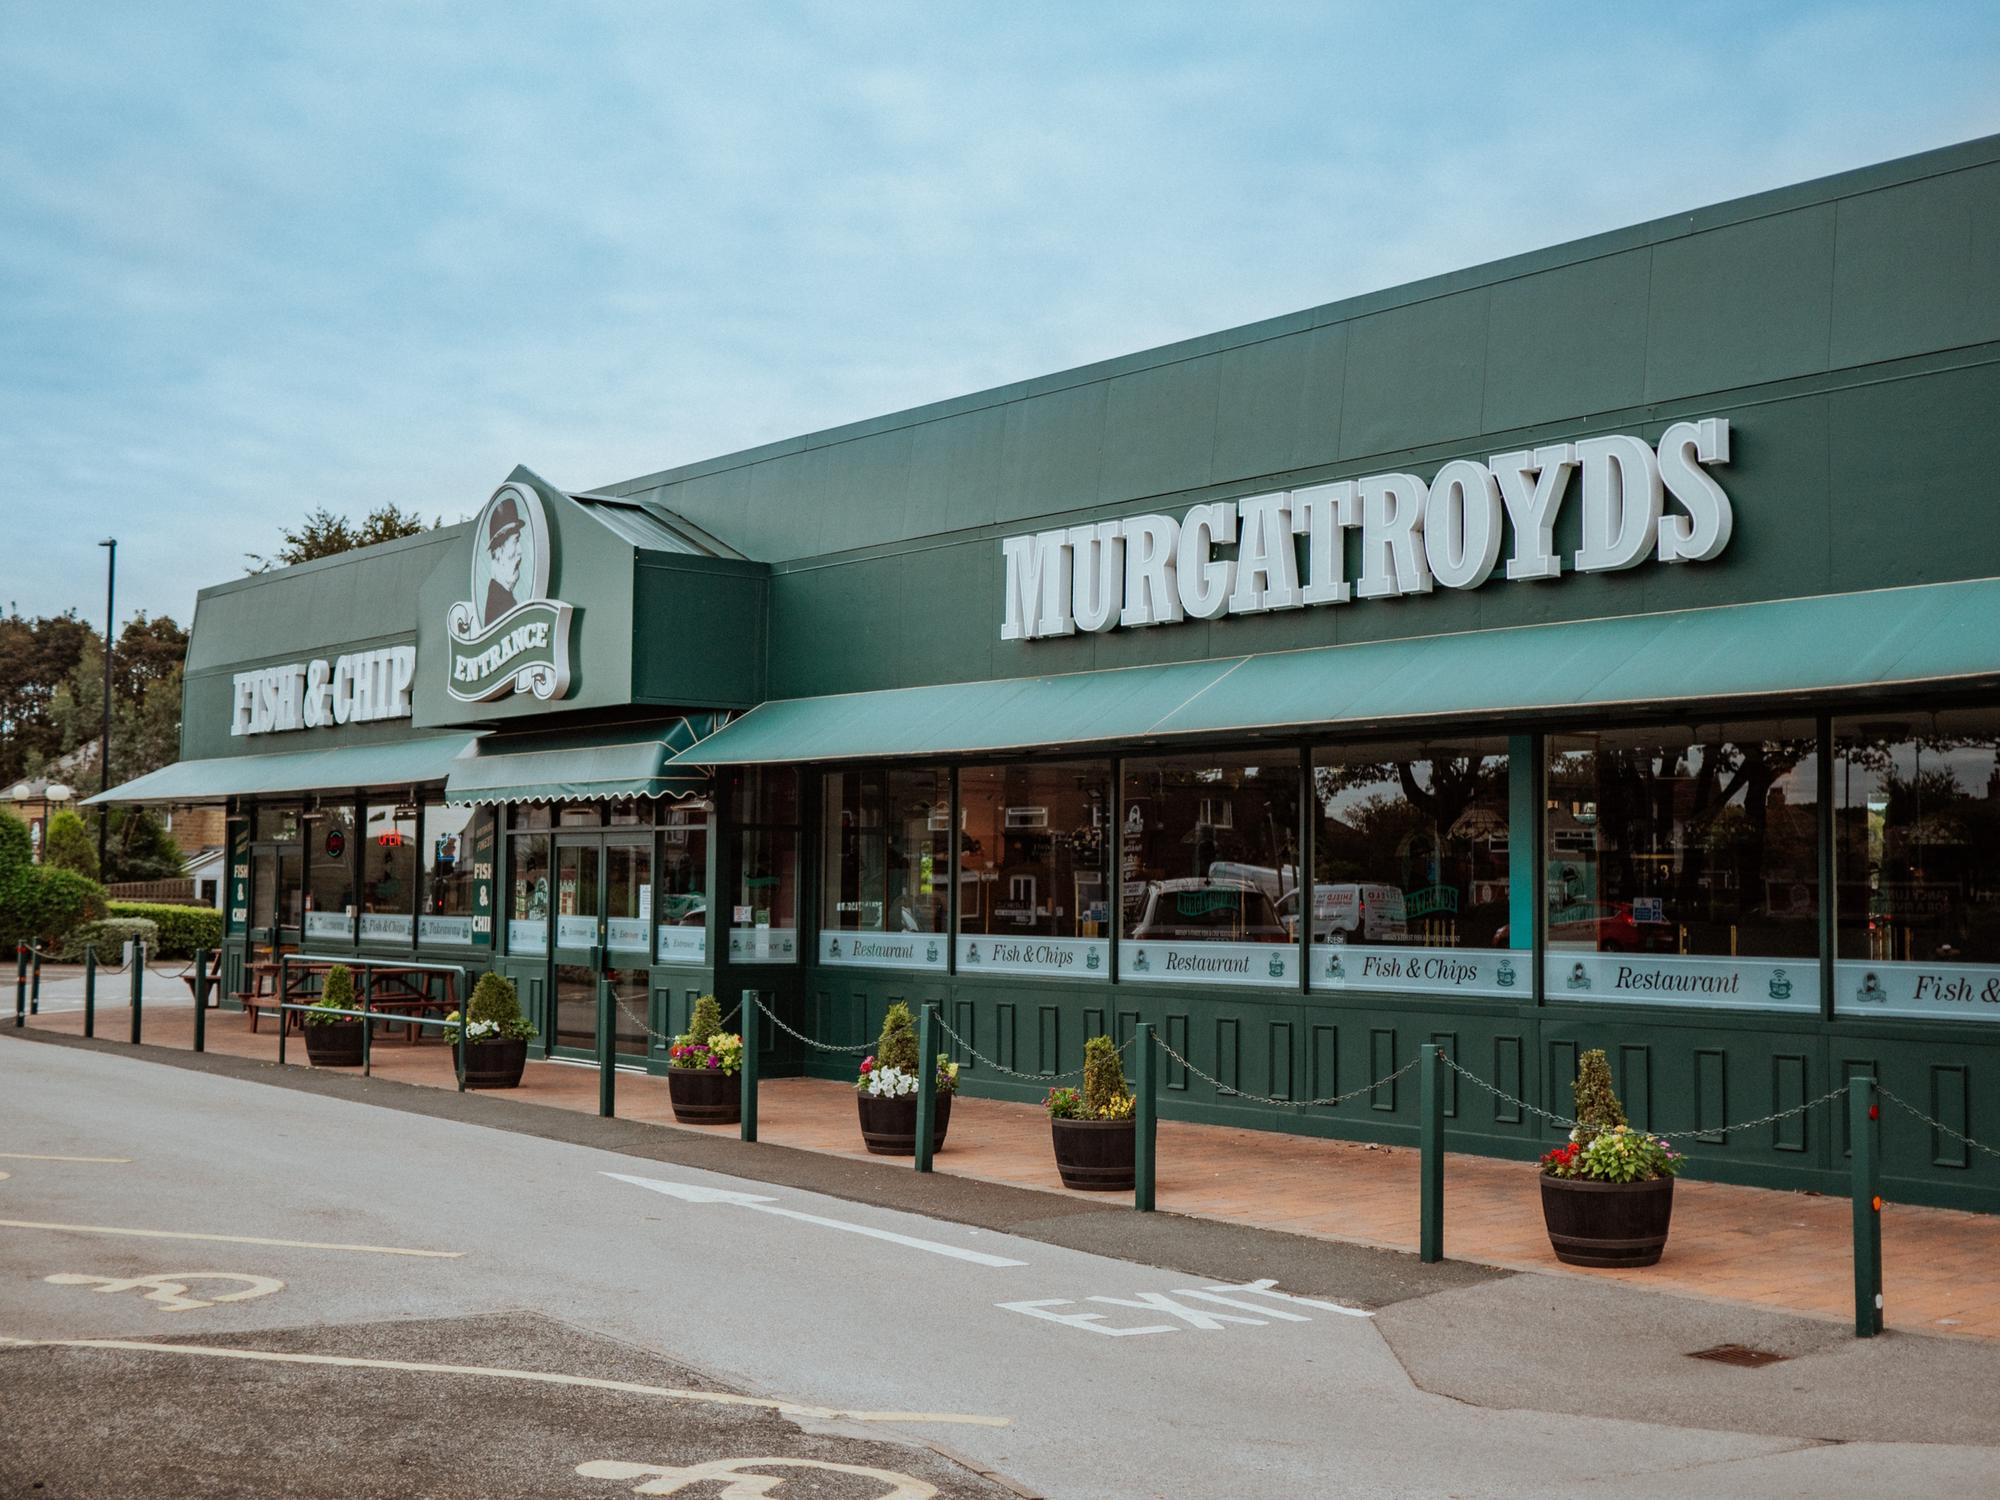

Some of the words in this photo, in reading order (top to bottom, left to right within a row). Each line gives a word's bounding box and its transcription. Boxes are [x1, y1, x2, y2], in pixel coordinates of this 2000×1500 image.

[1001, 417, 1733, 641] MURGATROYDS
[454, 622, 549, 682] ENTRANCE
[231, 663, 307, 736] FISH
[304, 659, 334, 728] &
[480, 885, 488, 906] &
[853, 940, 914, 959] Restaurant
[991, 944, 1021, 962] Fish
[1023, 945, 1034, 963] &
[1036, 946, 1074, 967] Chips
[1165, 951, 1250, 973] Restaurant
[1363, 956, 1401, 978] Fish
[1406, 957, 1421, 979] &
[1424, 958, 1477, 985] Chips
[1615, 966, 1740, 994] Restaurant
[1912, 975, 1974, 1002] Fish
[1981, 978, 2000, 1003] &
[994, 1279, 1375, 1336] EXIT
